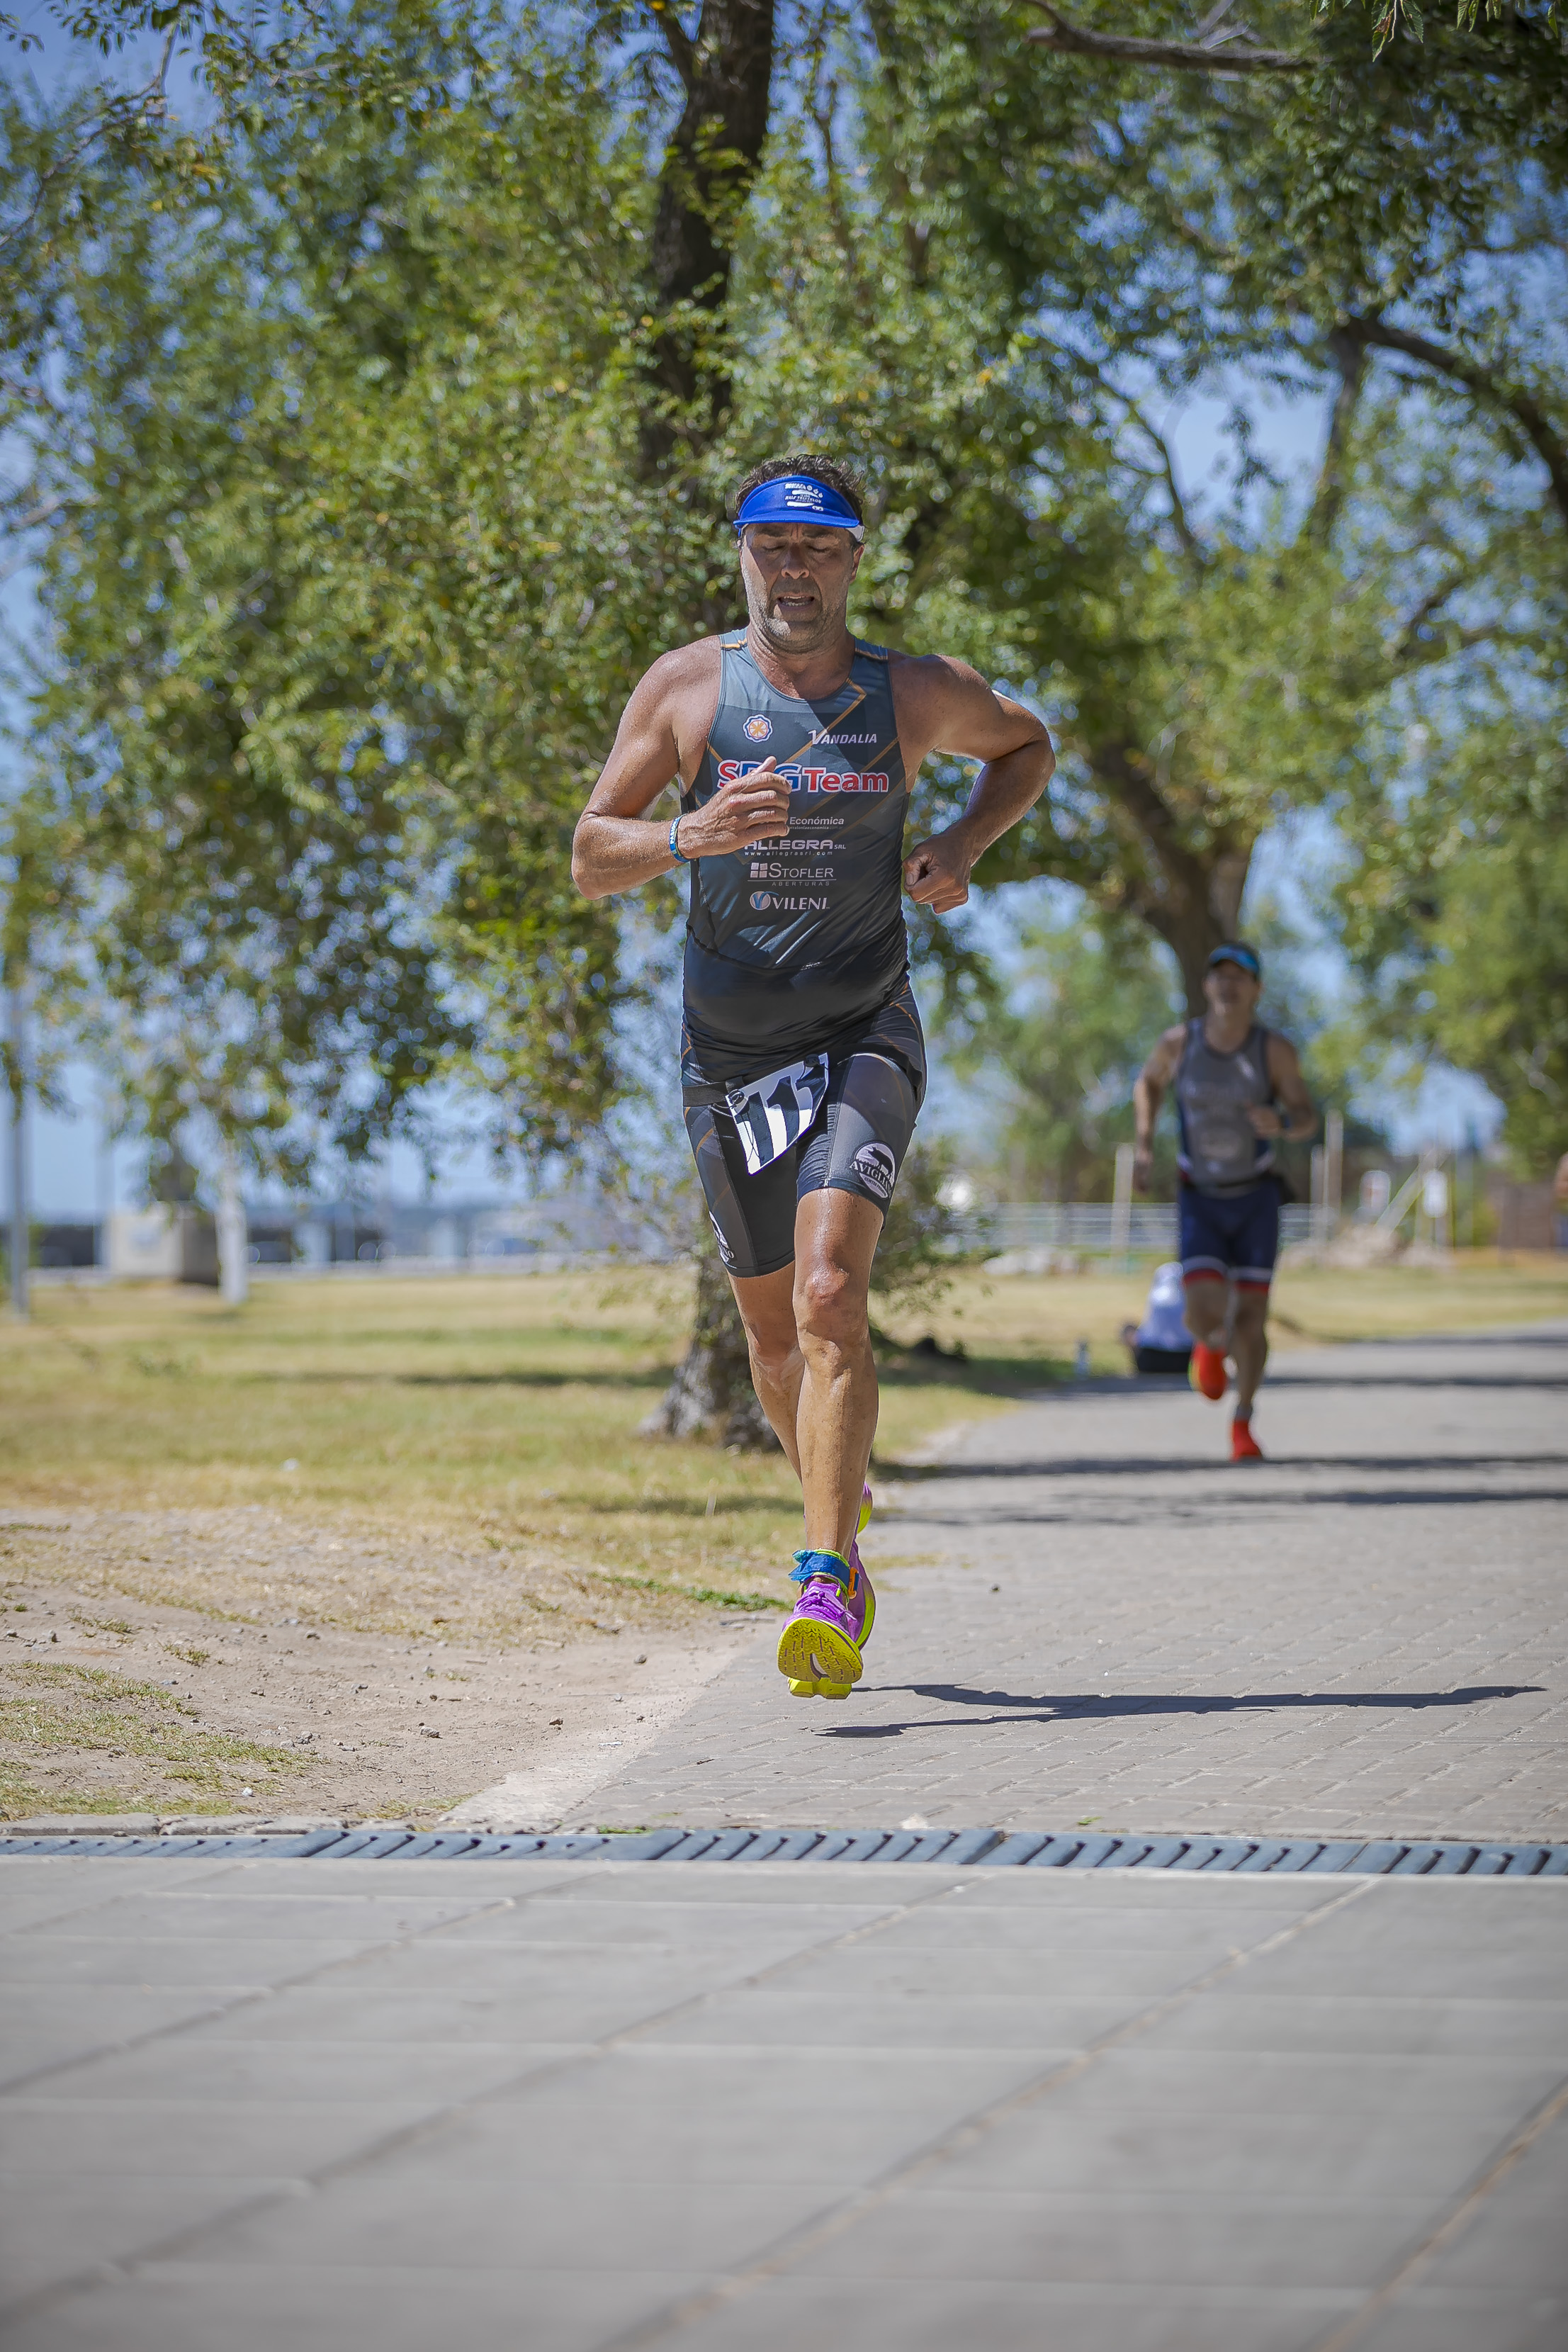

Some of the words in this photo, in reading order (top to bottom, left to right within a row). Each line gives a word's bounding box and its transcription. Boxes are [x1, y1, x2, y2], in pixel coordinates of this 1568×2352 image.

[808, 729, 877, 745] VANDALIA
[789, 816, 845, 825] Económica
[744, 840, 833, 850] ALLEGRA
[769, 862, 834, 878] STOFLER
[772, 897, 827, 910] VILENI
